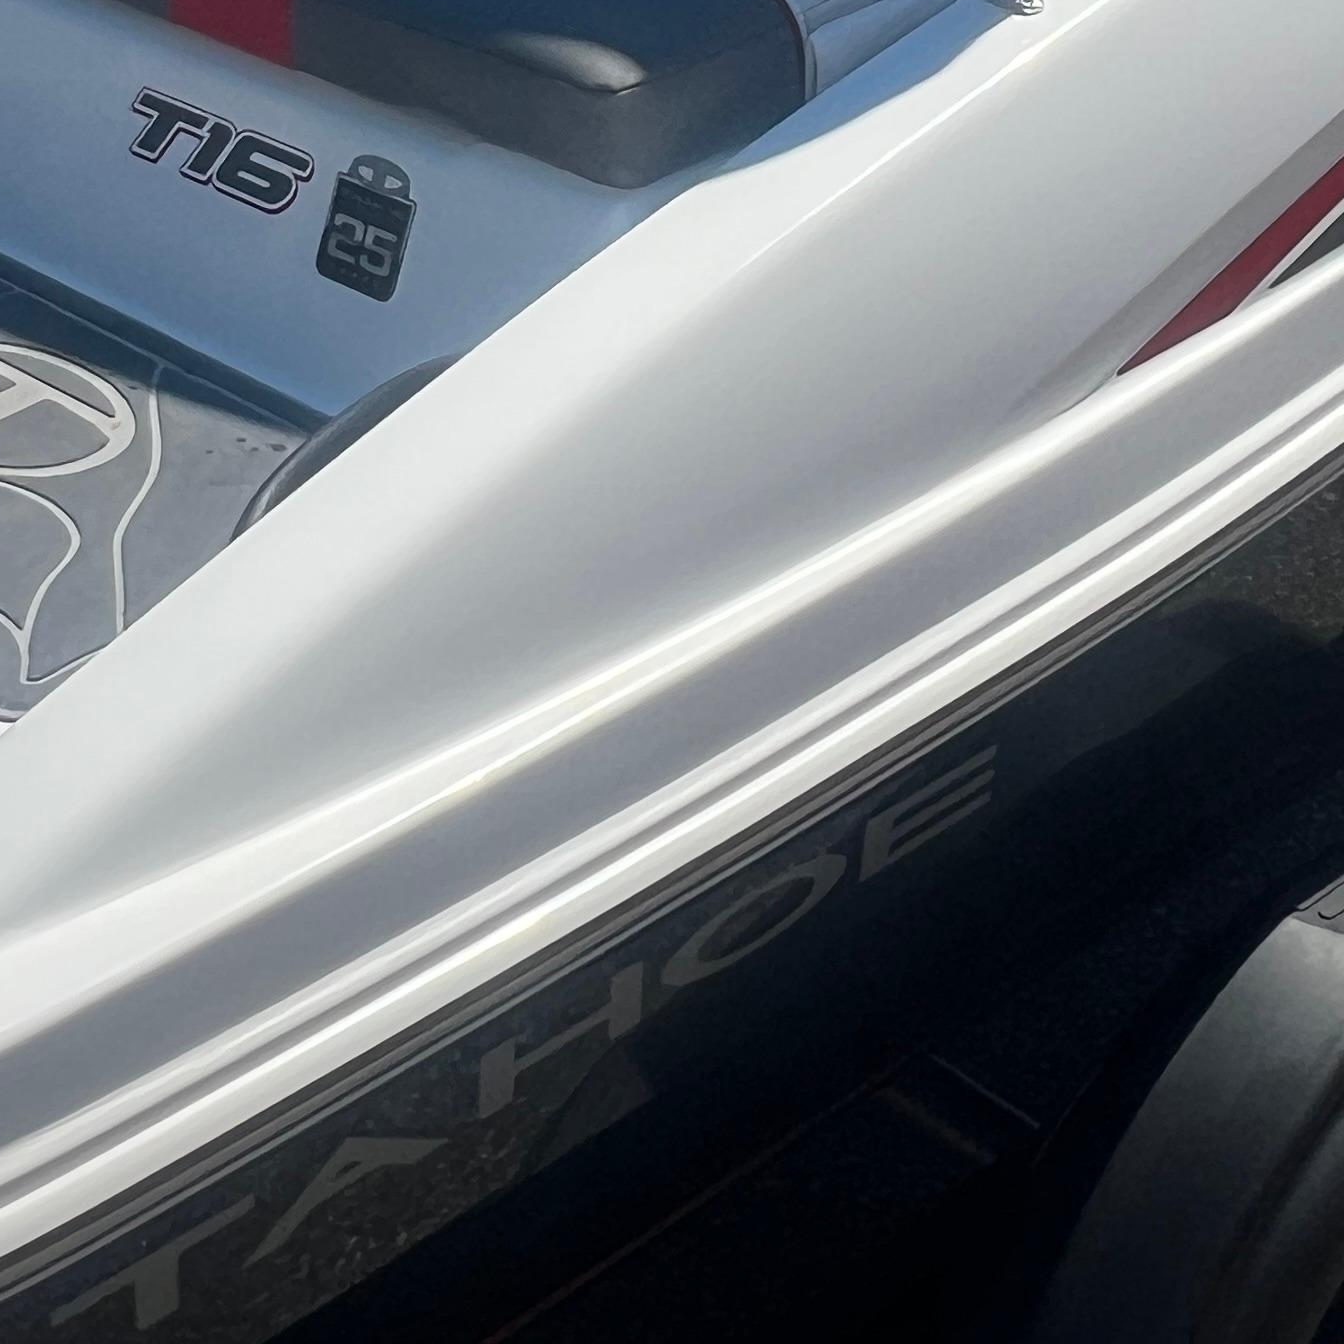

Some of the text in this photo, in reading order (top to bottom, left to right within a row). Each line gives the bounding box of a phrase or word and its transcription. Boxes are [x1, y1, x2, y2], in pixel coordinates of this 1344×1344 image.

[129, 86, 315, 215] T16
[327, 213, 398, 277] 25
[51, 746, 997, 1329] TAHOE
